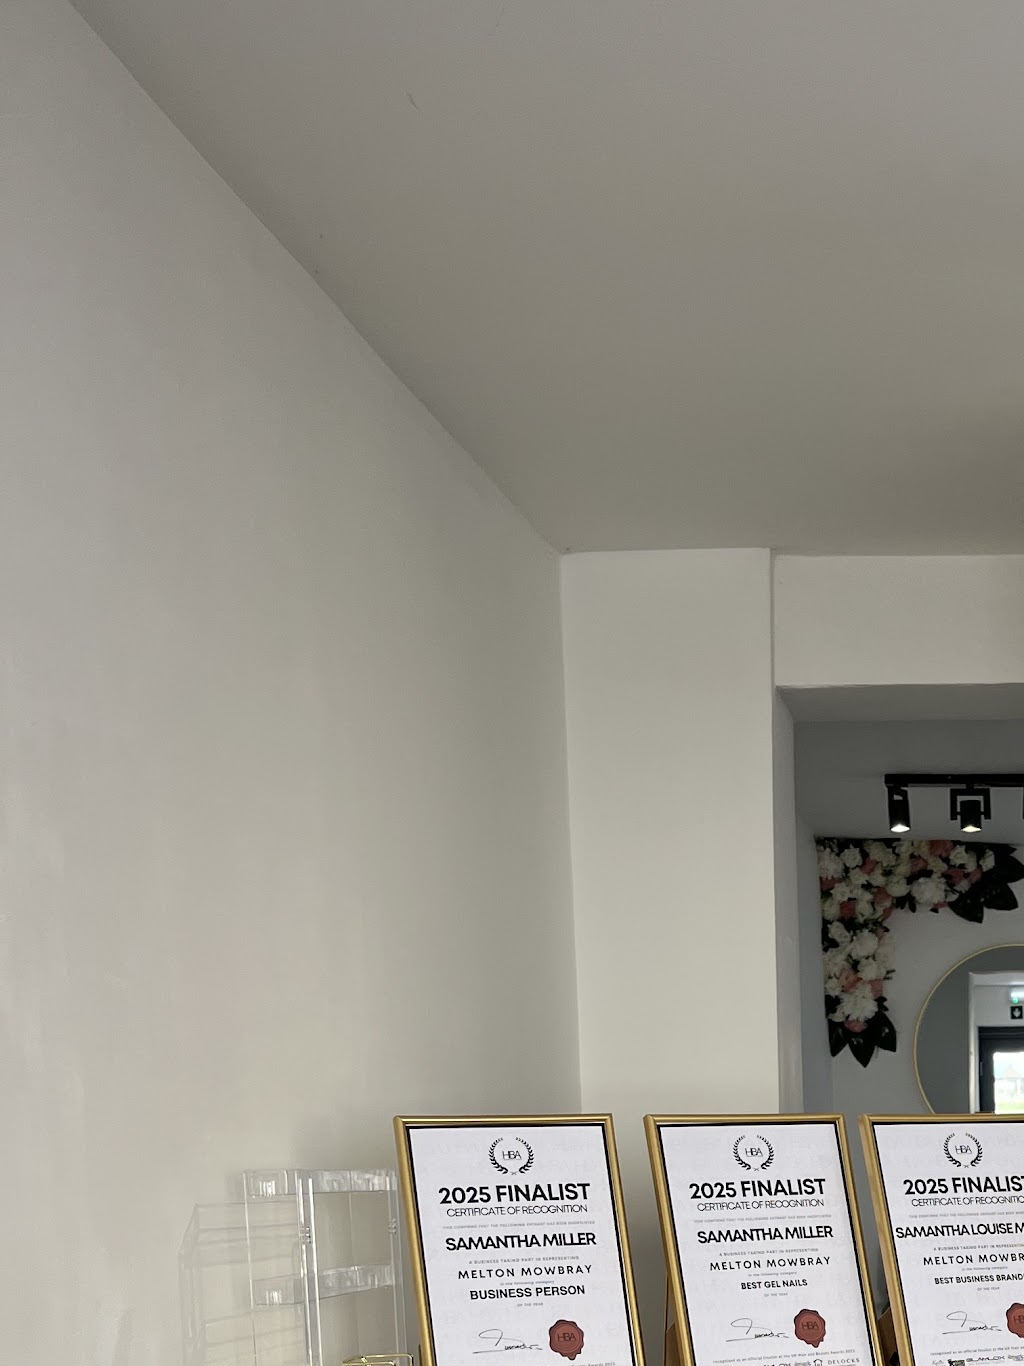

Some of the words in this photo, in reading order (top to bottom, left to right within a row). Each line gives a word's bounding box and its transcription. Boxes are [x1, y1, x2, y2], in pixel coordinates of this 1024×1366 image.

[502, 1151, 522, 1160] HBA
[955, 1146, 972, 1154] HBA
[438, 1186, 491, 1204] 2025
[496, 1183, 590, 1202] FINALIST
[689, 1182, 737, 1199] 2025
[741, 1179, 825, 1197] FINALIST
[903, 1179, 948, 1195] 2025
[697, 1201, 751, 1211] CERTIFICATE
[752, 1200, 764, 1209] OF
[765, 1199, 824, 1208] RECOGNITION
[912, 1198, 962, 1207] CERTIFICATE
[963, 1197, 974, 1205] OF
[447, 1206, 506, 1217] CERTIFICATE
[507, 1206, 520, 1215] OF
[522, 1204, 587, 1214] RECOGNITION
[697, 1228, 783, 1244] SAMANTHA
[786, 1226, 834, 1238] MILLER
[896, 1224, 970, 1239] SAMANTHA
[971, 1222, 1013, 1235] LOUISE
[446, 1235, 541, 1251] SAMANTHA
[543, 1233, 597, 1246] MILLER
[710, 1260, 761, 1271] MELTON
[766, 1257, 831, 1268] MOWBRAY
[923, 1255, 973, 1265] MELTON
[458, 1268, 515, 1279] MELTON
[521, 1265, 592, 1276] MOWBRAY
[782, 1279, 808, 1287] NAILS
[956, 1275, 994, 1283] BUSINESS
[470, 1287, 532, 1300] BUSINESS
[536, 1285, 585, 1297] PERSON
[802, 1321, 818, 1330] HBA
[558, 1333, 576, 1342] HBA
